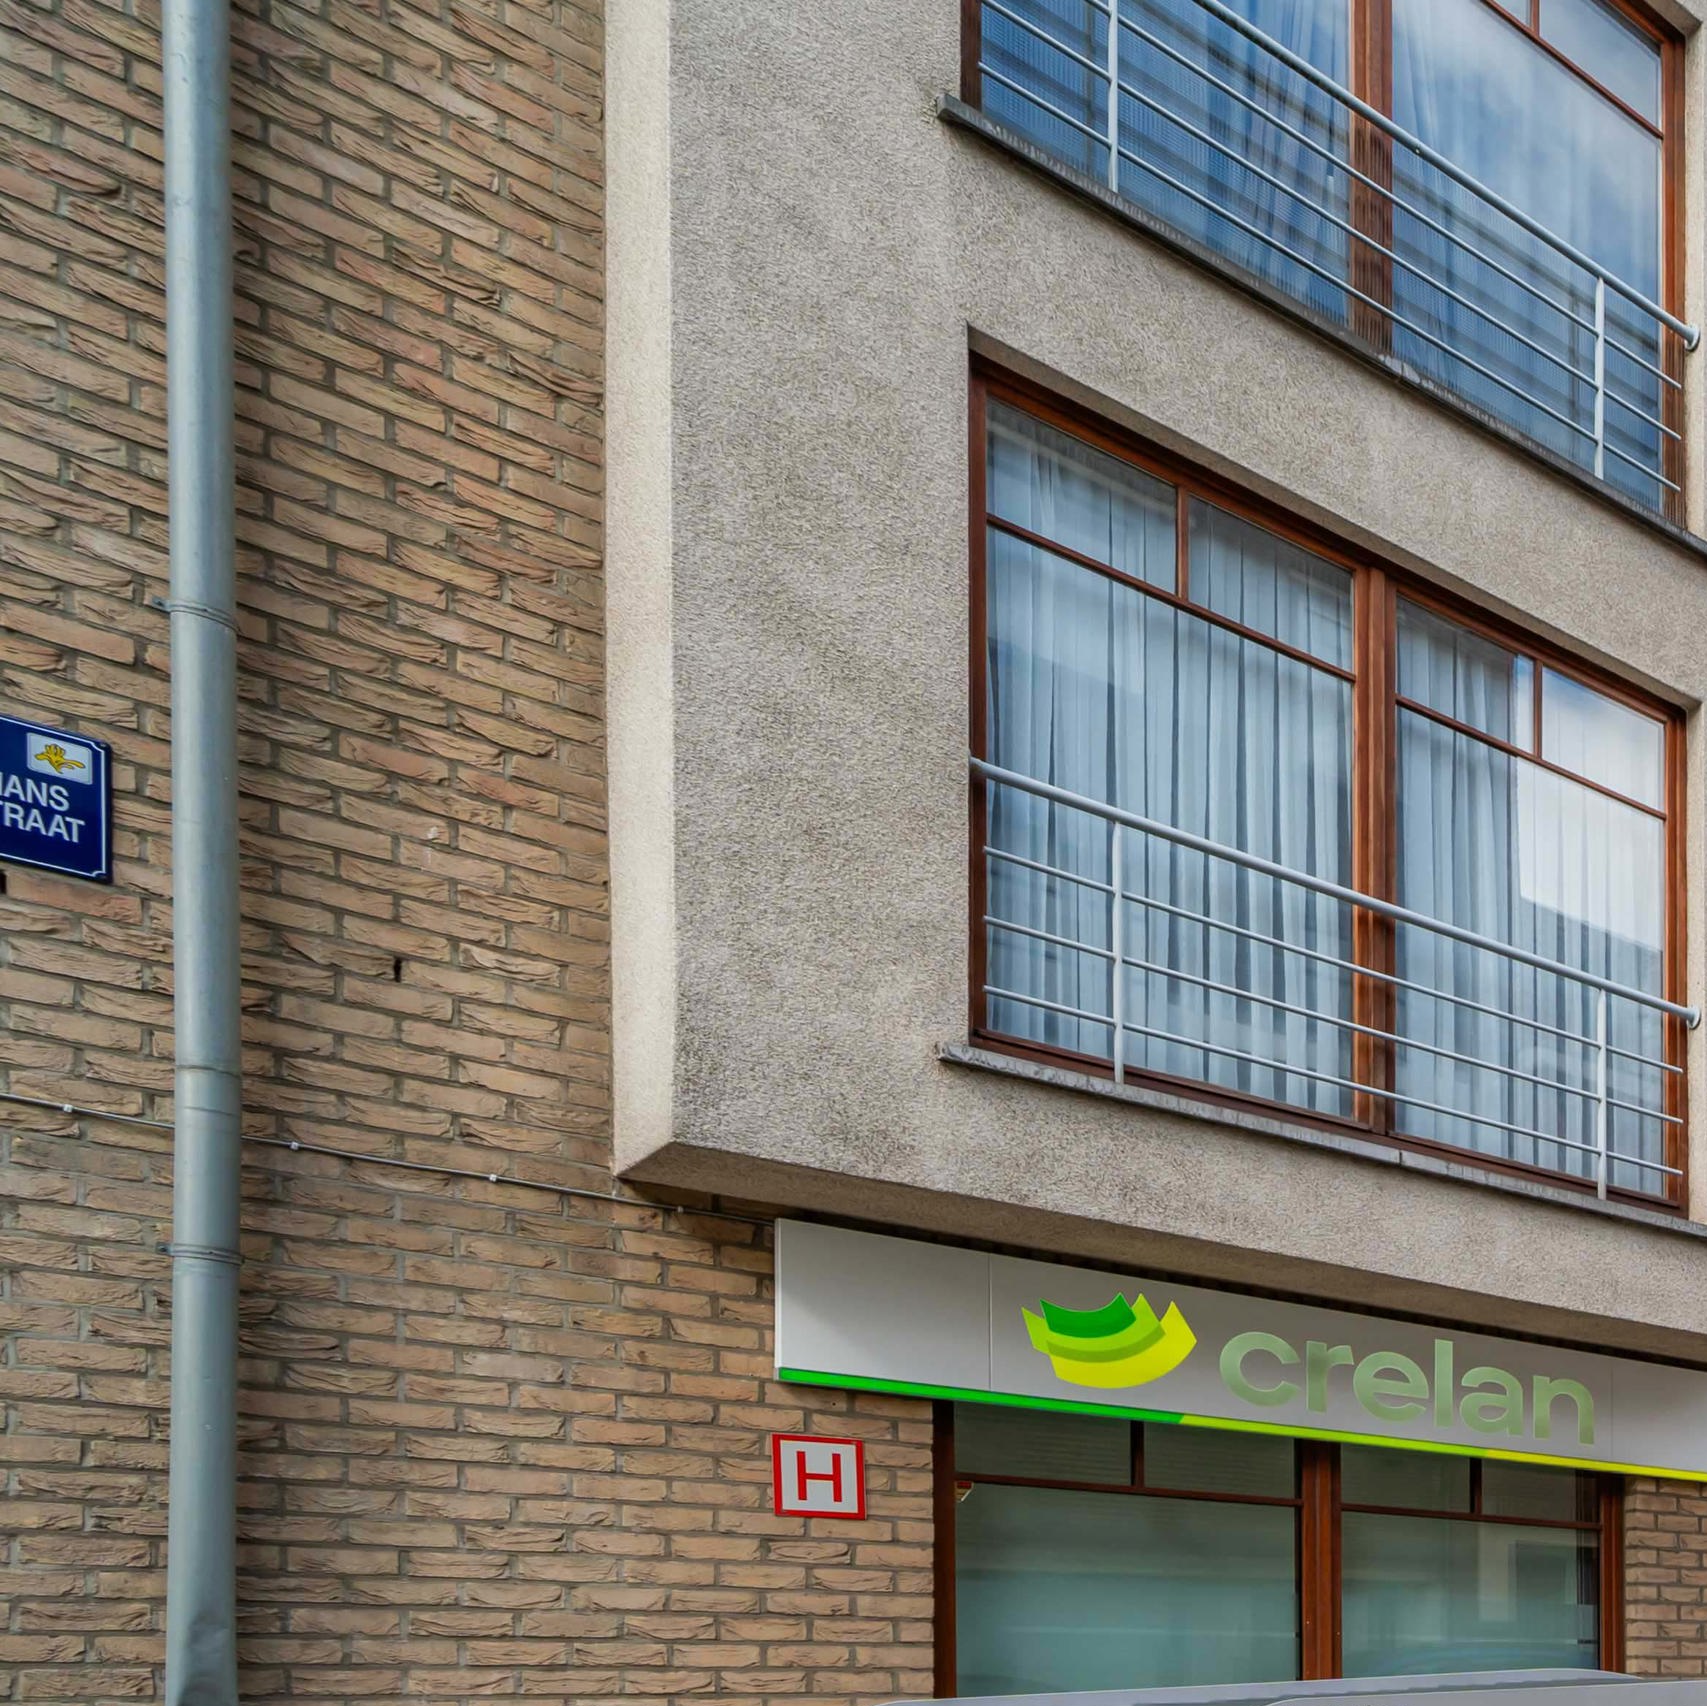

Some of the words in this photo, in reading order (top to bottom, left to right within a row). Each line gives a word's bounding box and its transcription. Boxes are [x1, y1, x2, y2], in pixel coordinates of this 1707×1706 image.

[0, 771, 70, 812] ANS
[1219, 1331, 1595, 1445] crelan
[796, 1450, 842, 1503] H
